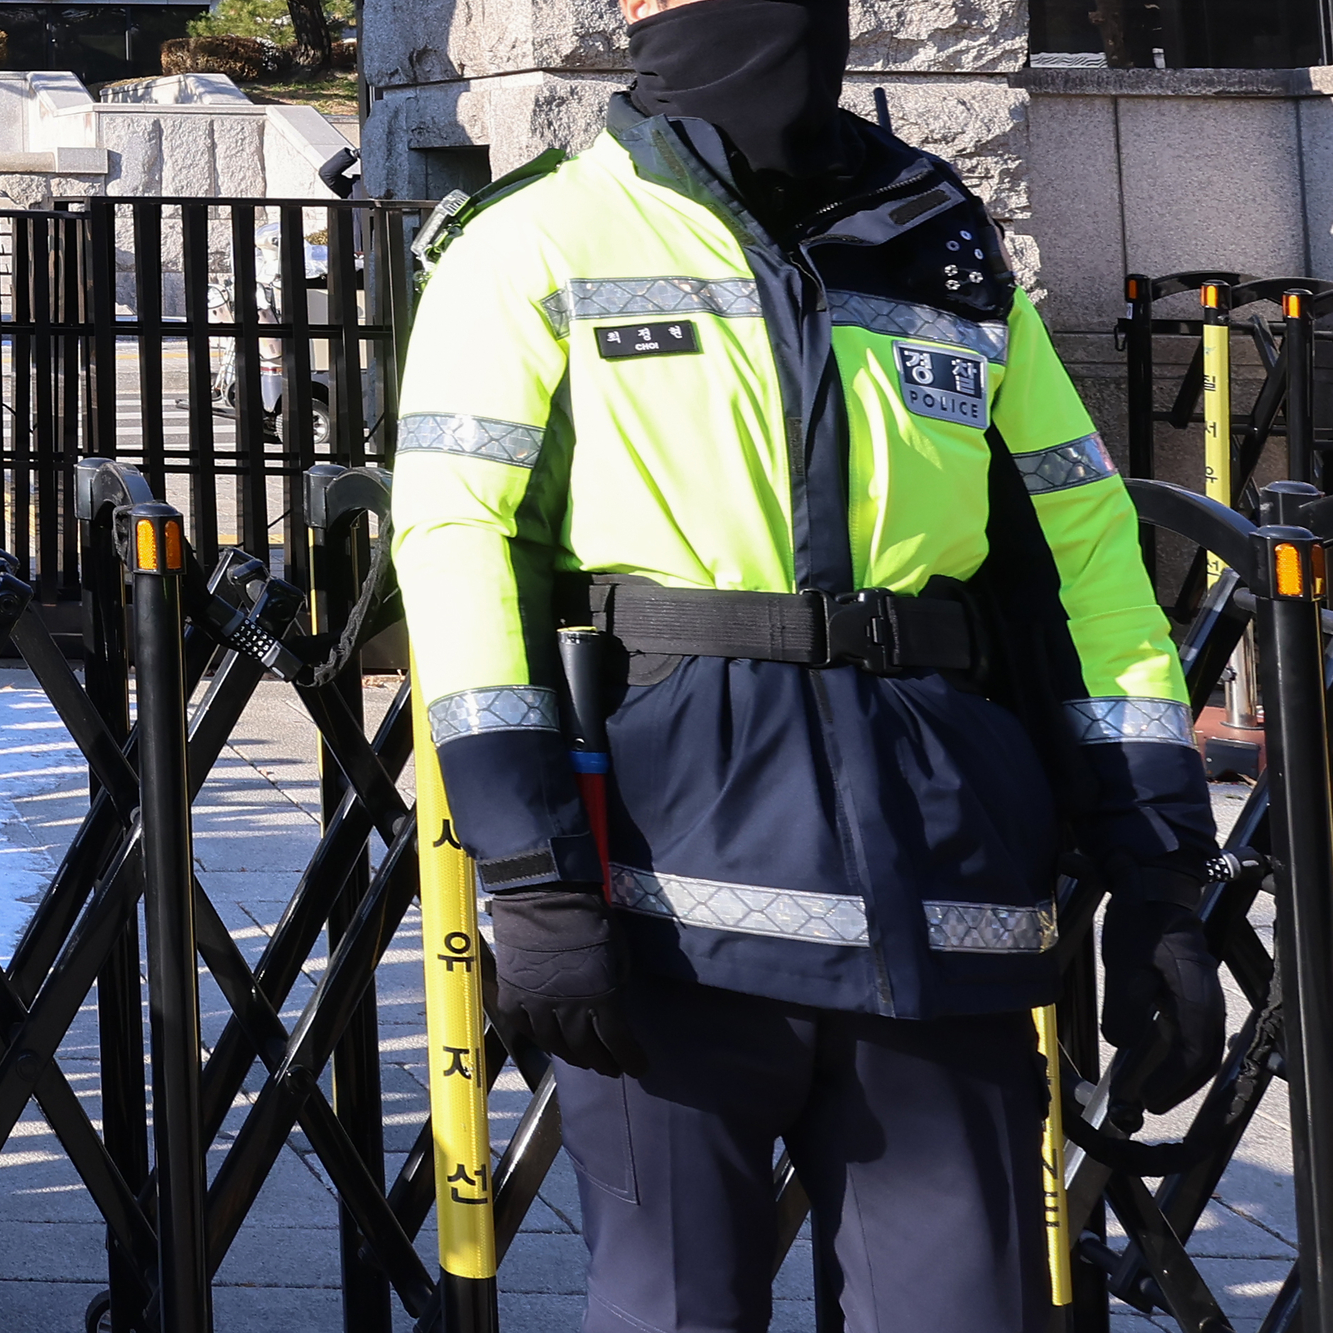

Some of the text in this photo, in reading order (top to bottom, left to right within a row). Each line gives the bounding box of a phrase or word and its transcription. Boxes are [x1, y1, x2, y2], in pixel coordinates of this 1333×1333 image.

[634, 341, 660, 351] CHOI
[903, 350, 978, 395] 경찰
[909, 389, 979, 419] POLICE
